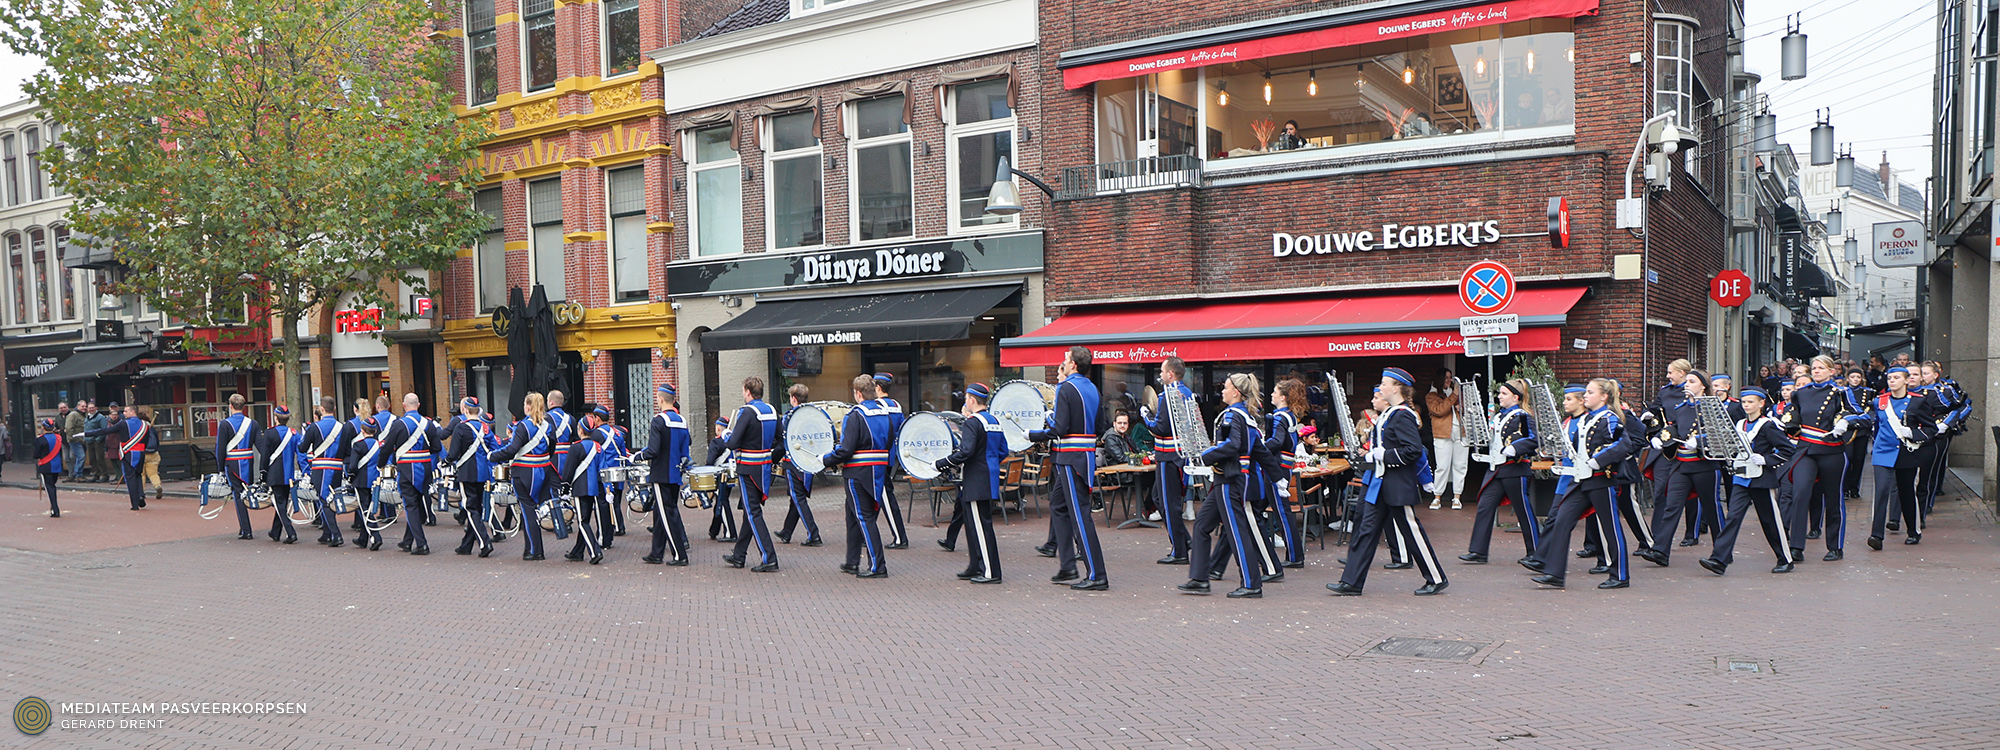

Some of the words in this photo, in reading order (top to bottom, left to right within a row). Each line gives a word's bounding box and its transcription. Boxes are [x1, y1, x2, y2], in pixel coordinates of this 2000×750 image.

[1378, 24, 1410, 35] Douwe
[1411, 18, 1447, 30] EGBERTS
[1451, 12, 1476, 27] koffie
[1476, 11, 1487, 21] &
[1487, 6, 1507, 19] lunch
[1129, 61, 1155, 72] Douwe
[1156, 56, 1186, 68] EGBERTS
[1190, 51, 1211, 63] koffie
[1211, 51, 1219, 60] &
[1219, 47, 1238, 59] lunch
[1273, 230, 1373, 257] Douwe
[1382, 219, 1500, 249] EGBERTS
[1880, 240, 1918, 249] PERONI
[1786, 238, 1794, 276] KANTELAAR
[803, 254, 871, 284] Dünya
[875, 247, 945, 277] Döner
[1786, 277, 1794, 287] DE
[415, 298, 432, 316] F
[1463, 316, 1515, 326] uitgezonderd
[791, 332, 824, 344] DÜNYA
[827, 330, 862, 342] DÖNER
[1328, 342, 1362, 351] Douwe
[1364, 341, 1401, 350] EGBERTS
[1407, 336, 1433, 352] koffie
[1434, 340, 1445, 348] &
[1094, 350, 1124, 359] EGBERTS
[1128, 347, 1149, 361] koffie
[1150, 350, 1159, 358] &
[20, 363, 59, 378] SHOOTER
[790, 432, 832, 441] PASVEER
